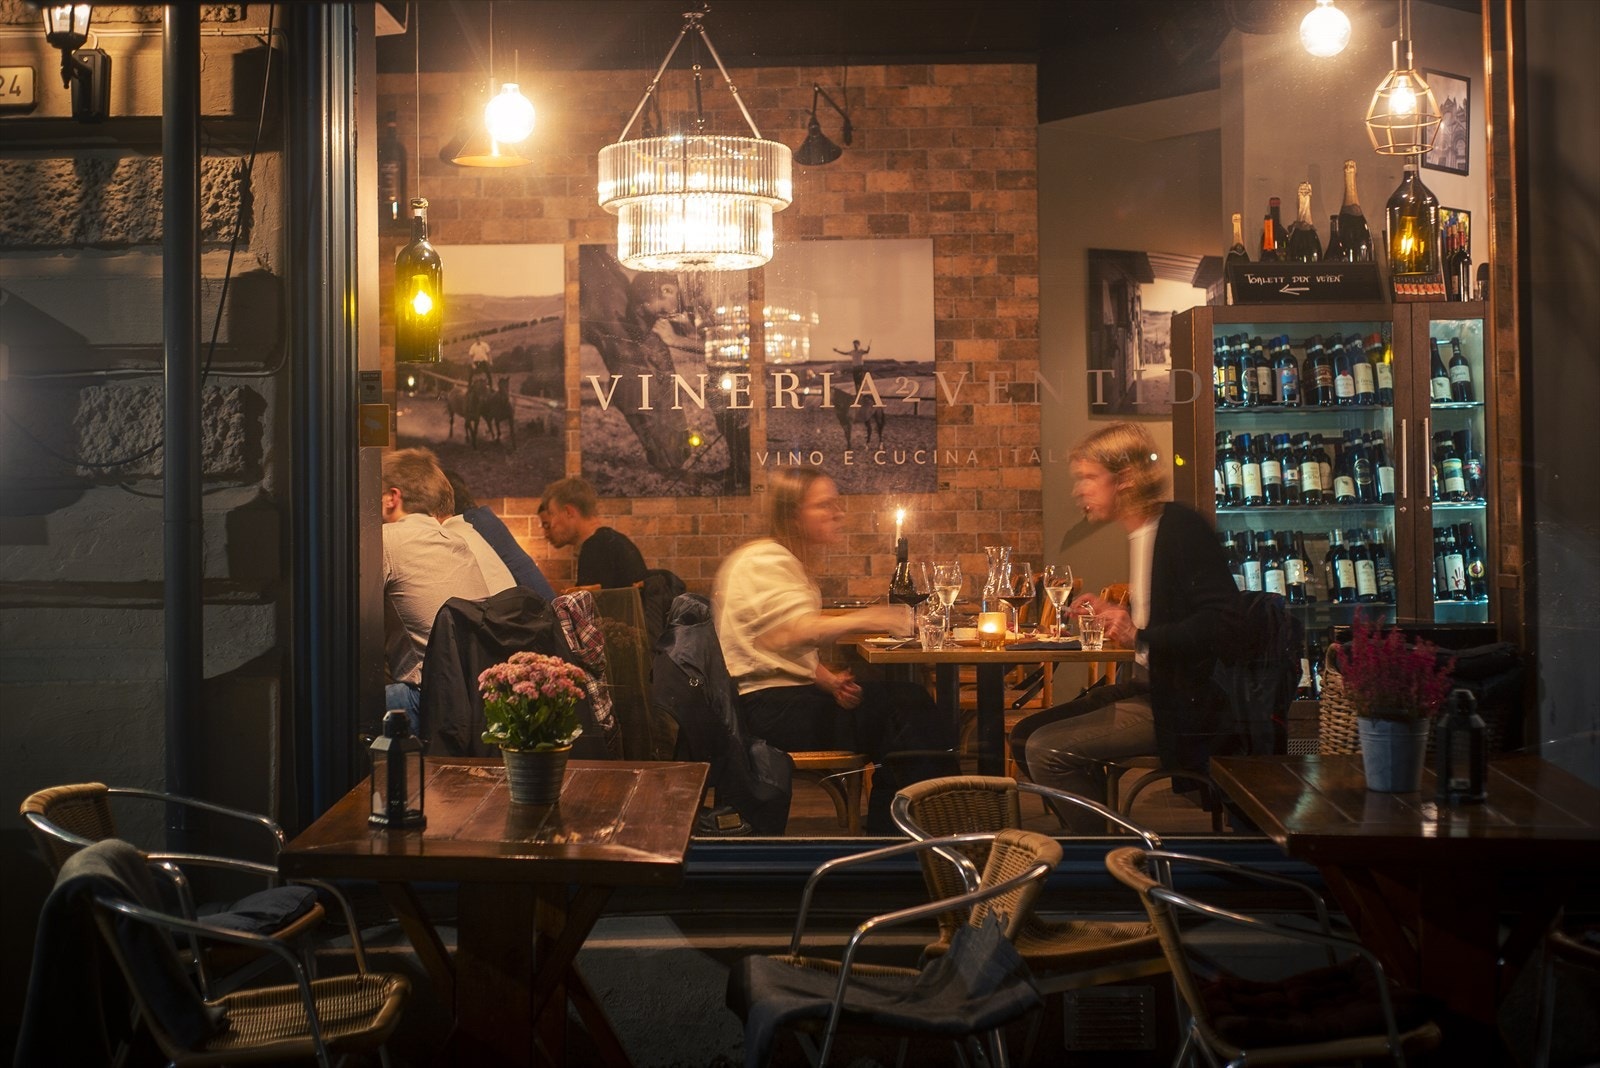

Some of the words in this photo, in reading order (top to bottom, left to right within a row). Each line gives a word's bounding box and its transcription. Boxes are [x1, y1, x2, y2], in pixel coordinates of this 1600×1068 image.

[586, 371, 887, 411] VINERIA
[756, 450, 824, 466] VINO
[844, 450, 854, 465] E
[874, 449, 979, 466] CUCINA
[999, 448, 1130, 463] ITALINA
